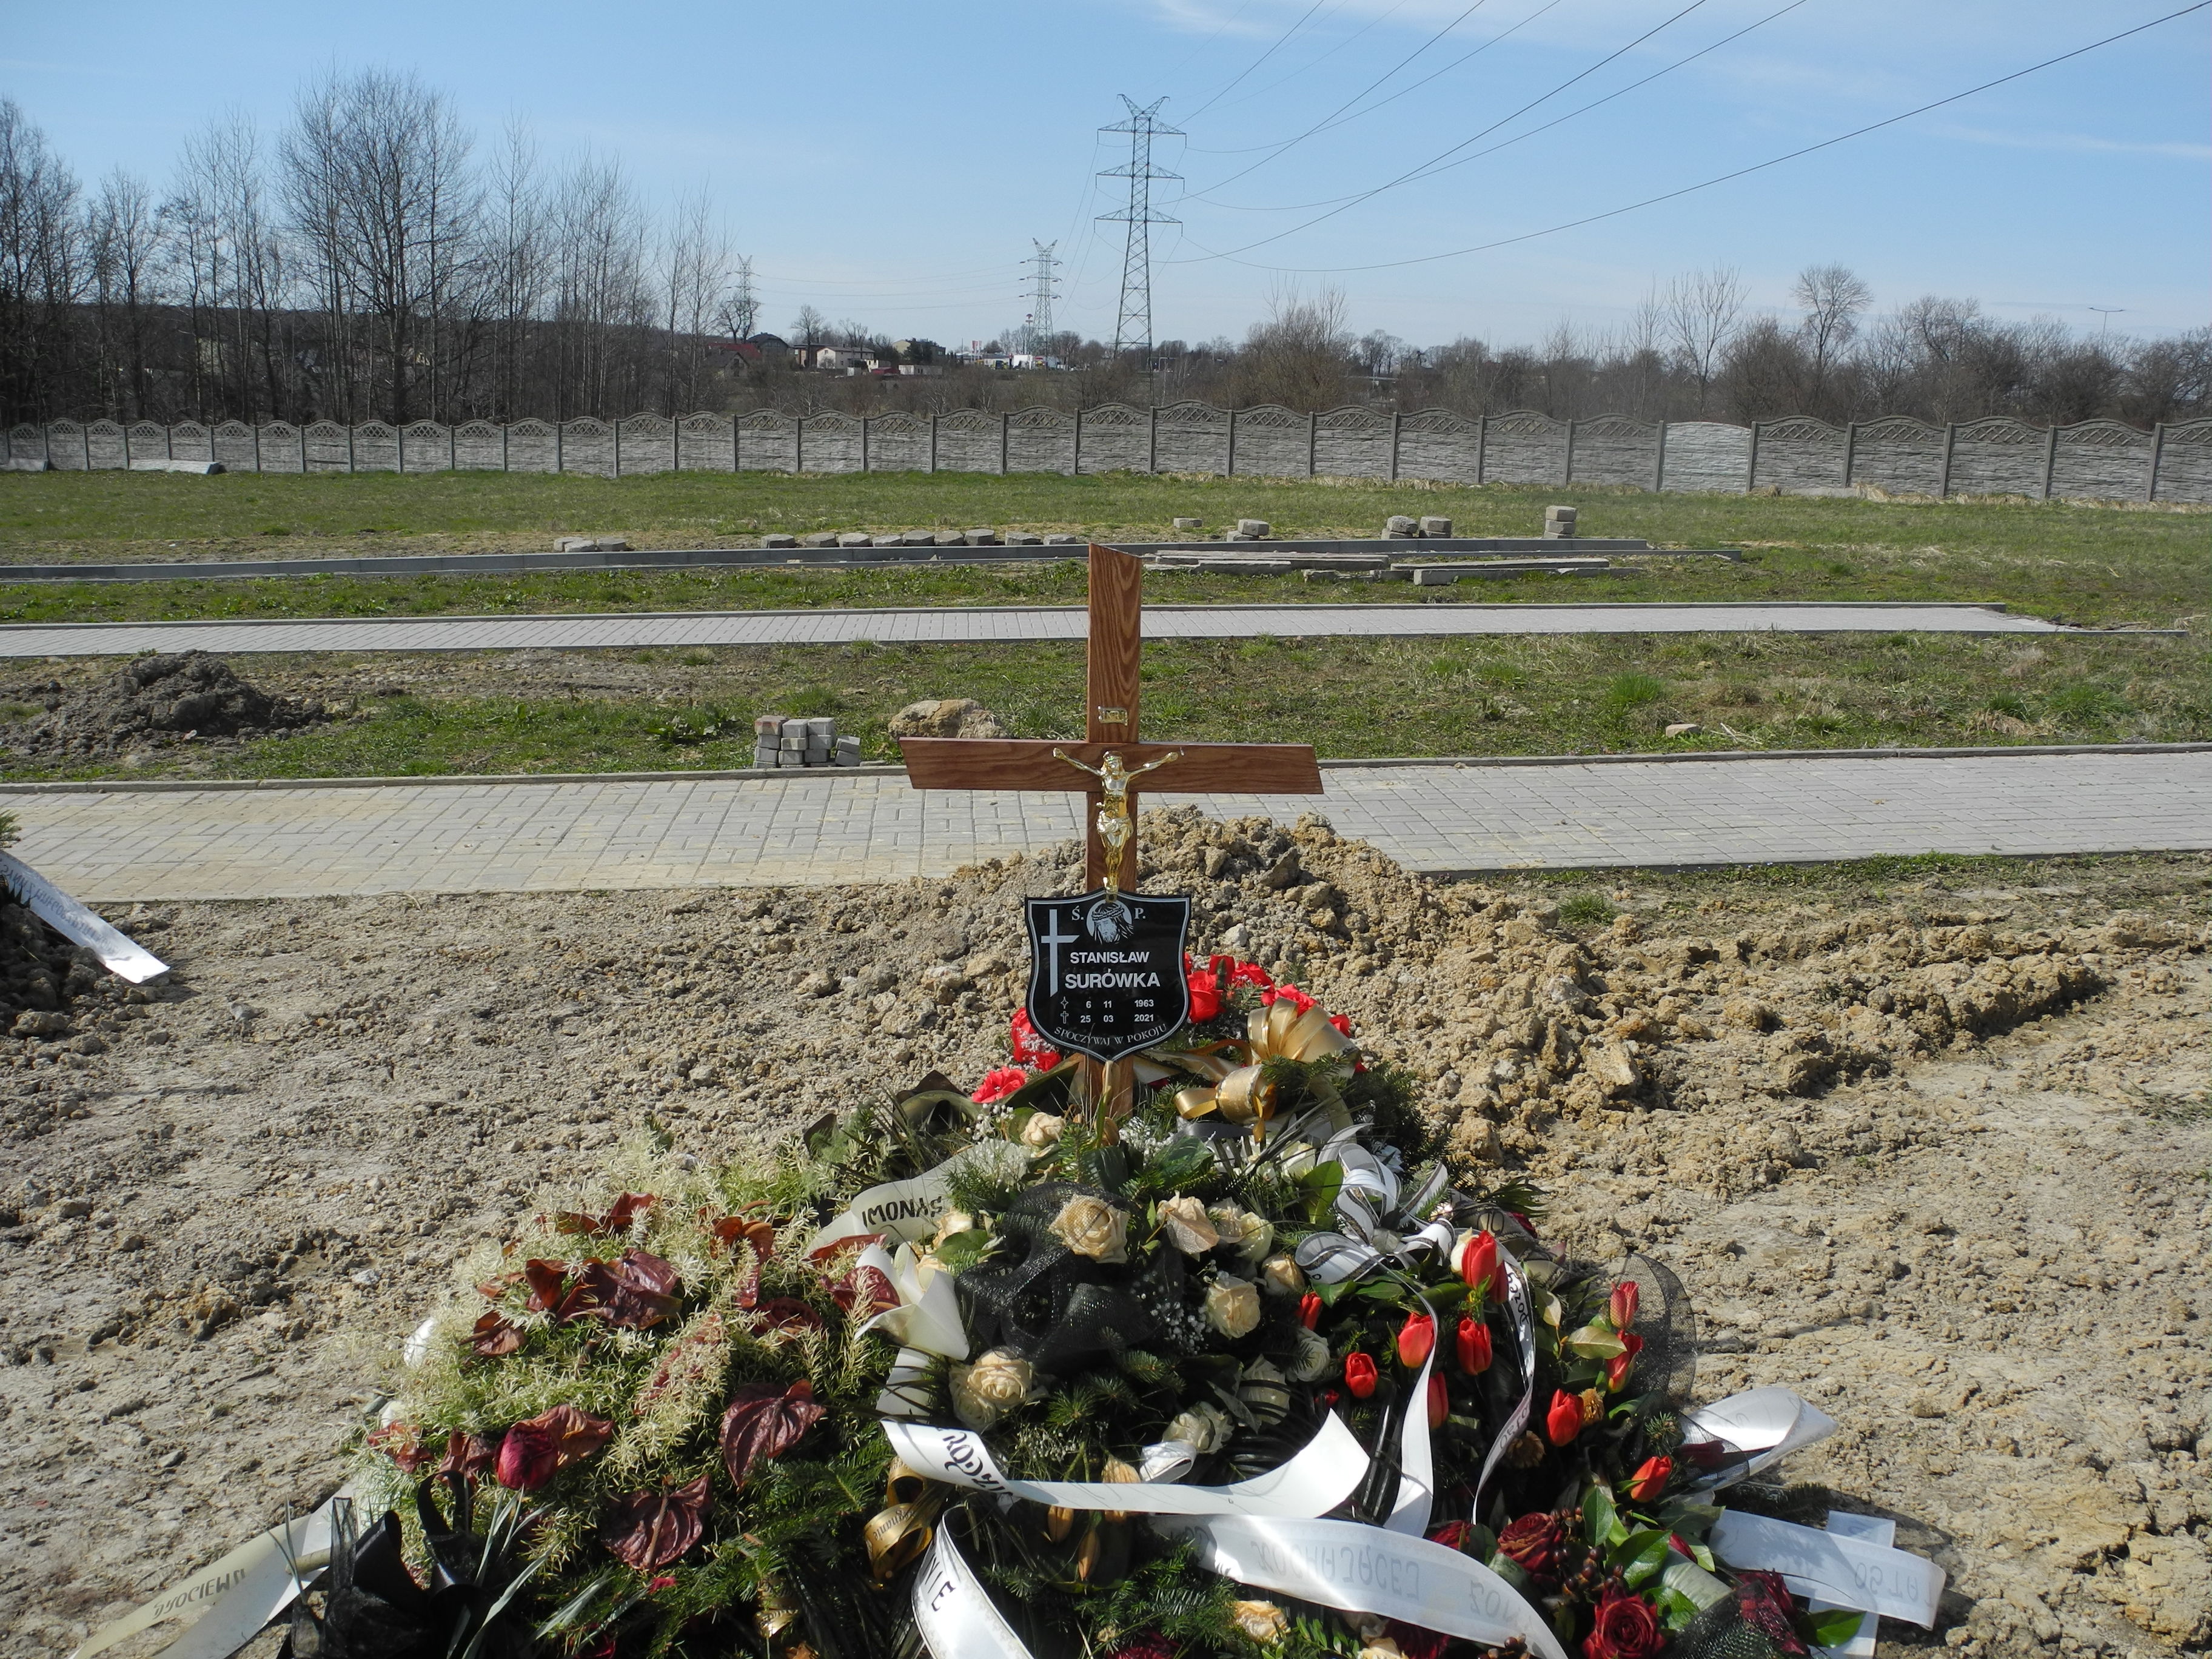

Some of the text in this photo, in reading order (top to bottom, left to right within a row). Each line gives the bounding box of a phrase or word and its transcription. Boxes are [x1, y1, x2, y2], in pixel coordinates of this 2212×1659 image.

[1070, 951, 1150, 964] STANISŁAW
[1064, 968, 1161, 990] SURÓWKA
[1085, 999, 1155, 1009] 6 11 1963
[1080, 1014, 1155, 1024] 25 03 2021
[1054, 1026, 1110, 1045] SPOCZYWAJ
[1127, 1023, 1167, 1043] POKOJU
[861, 1196, 943, 1228] SYNOWI
